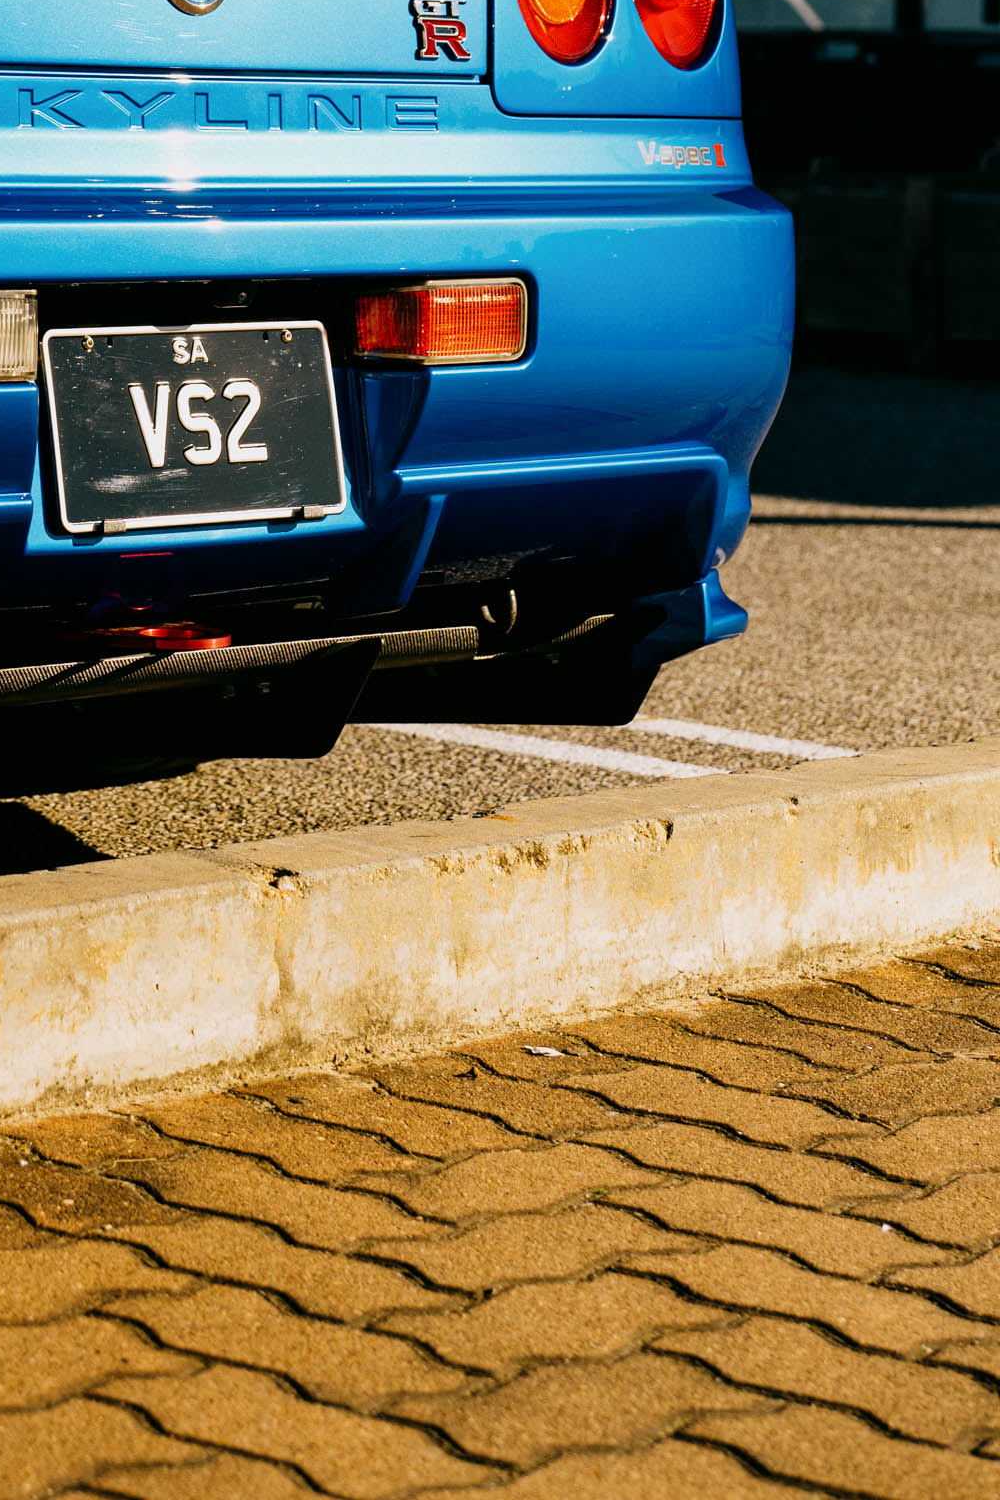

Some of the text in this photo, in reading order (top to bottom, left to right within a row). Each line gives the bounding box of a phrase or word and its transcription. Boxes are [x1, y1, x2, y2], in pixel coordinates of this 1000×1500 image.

[417, 17, 473, 60] R
[171, 336, 209, 365] SA
[127, 377, 269, 469] VS2
